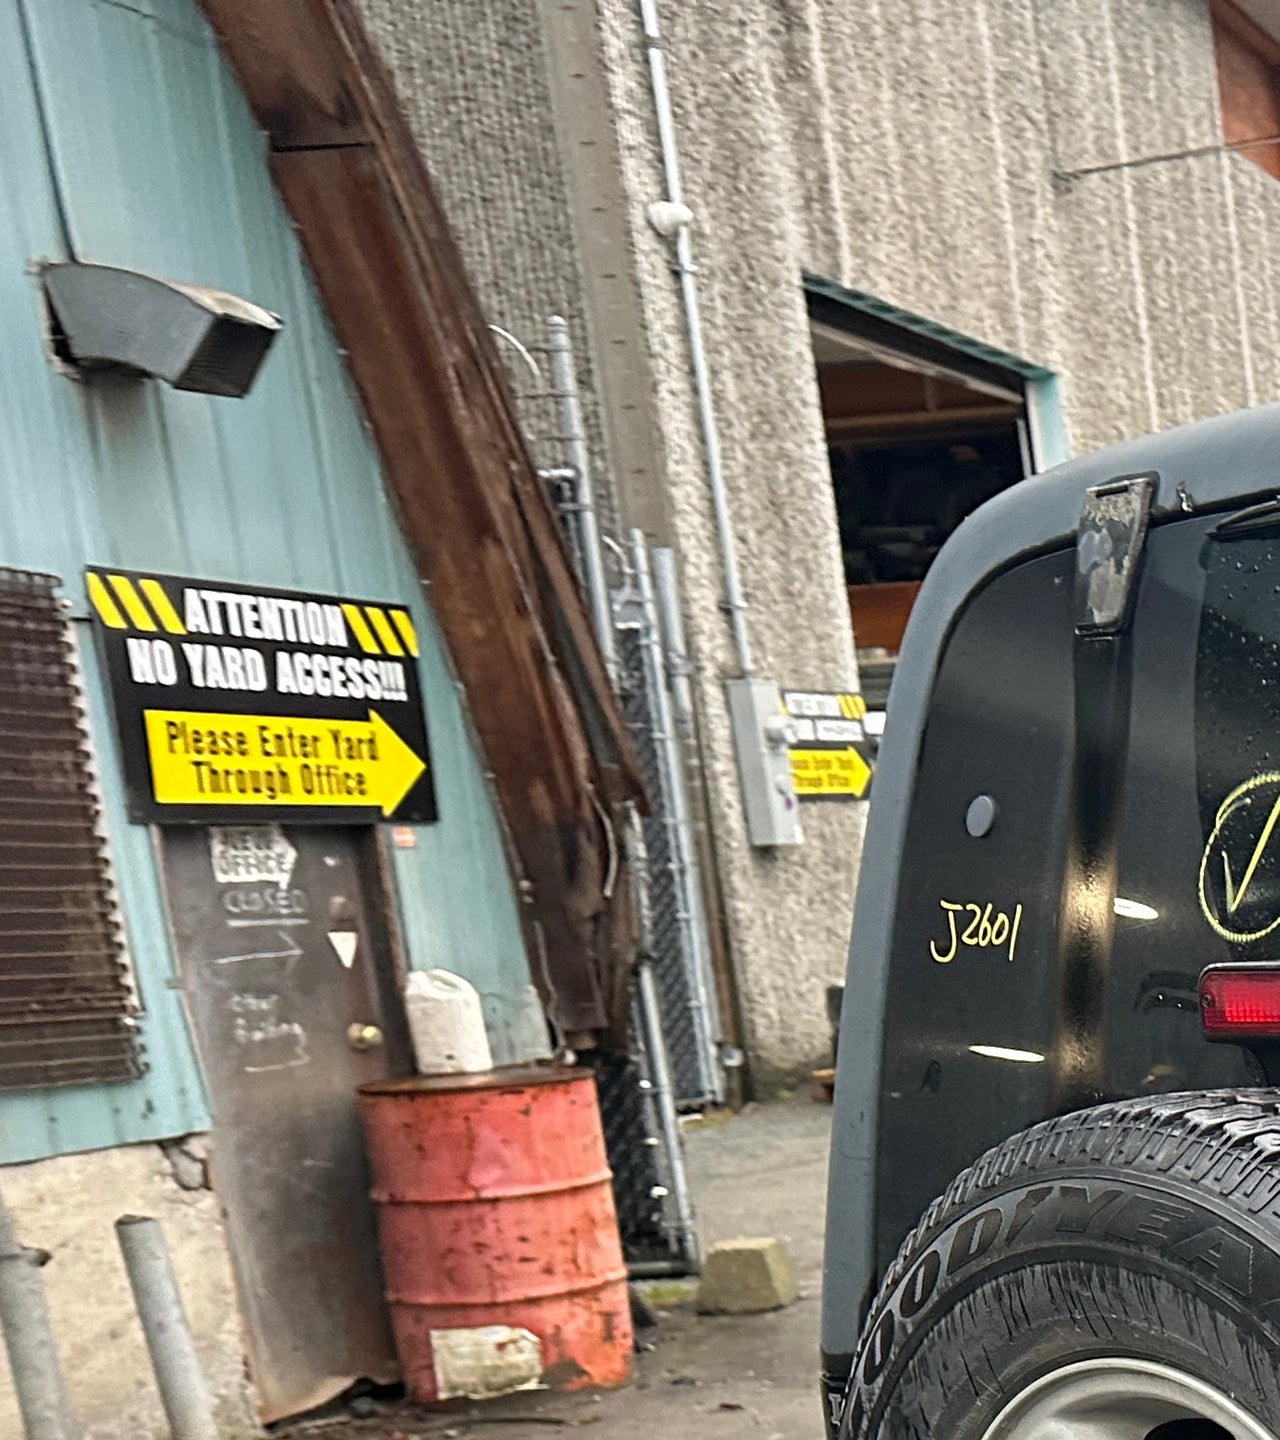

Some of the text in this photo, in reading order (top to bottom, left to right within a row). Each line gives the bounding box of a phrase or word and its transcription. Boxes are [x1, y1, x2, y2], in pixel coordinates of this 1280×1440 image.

[183, 588, 349, 648] ATTENTION
[126, 637, 409, 702] NO YARD ACCESS!!!
[164, 719, 380, 763] Please Enter Yard
[190, 760, 368, 801] Through Office
[930, 899, 1022, 964] J2601
